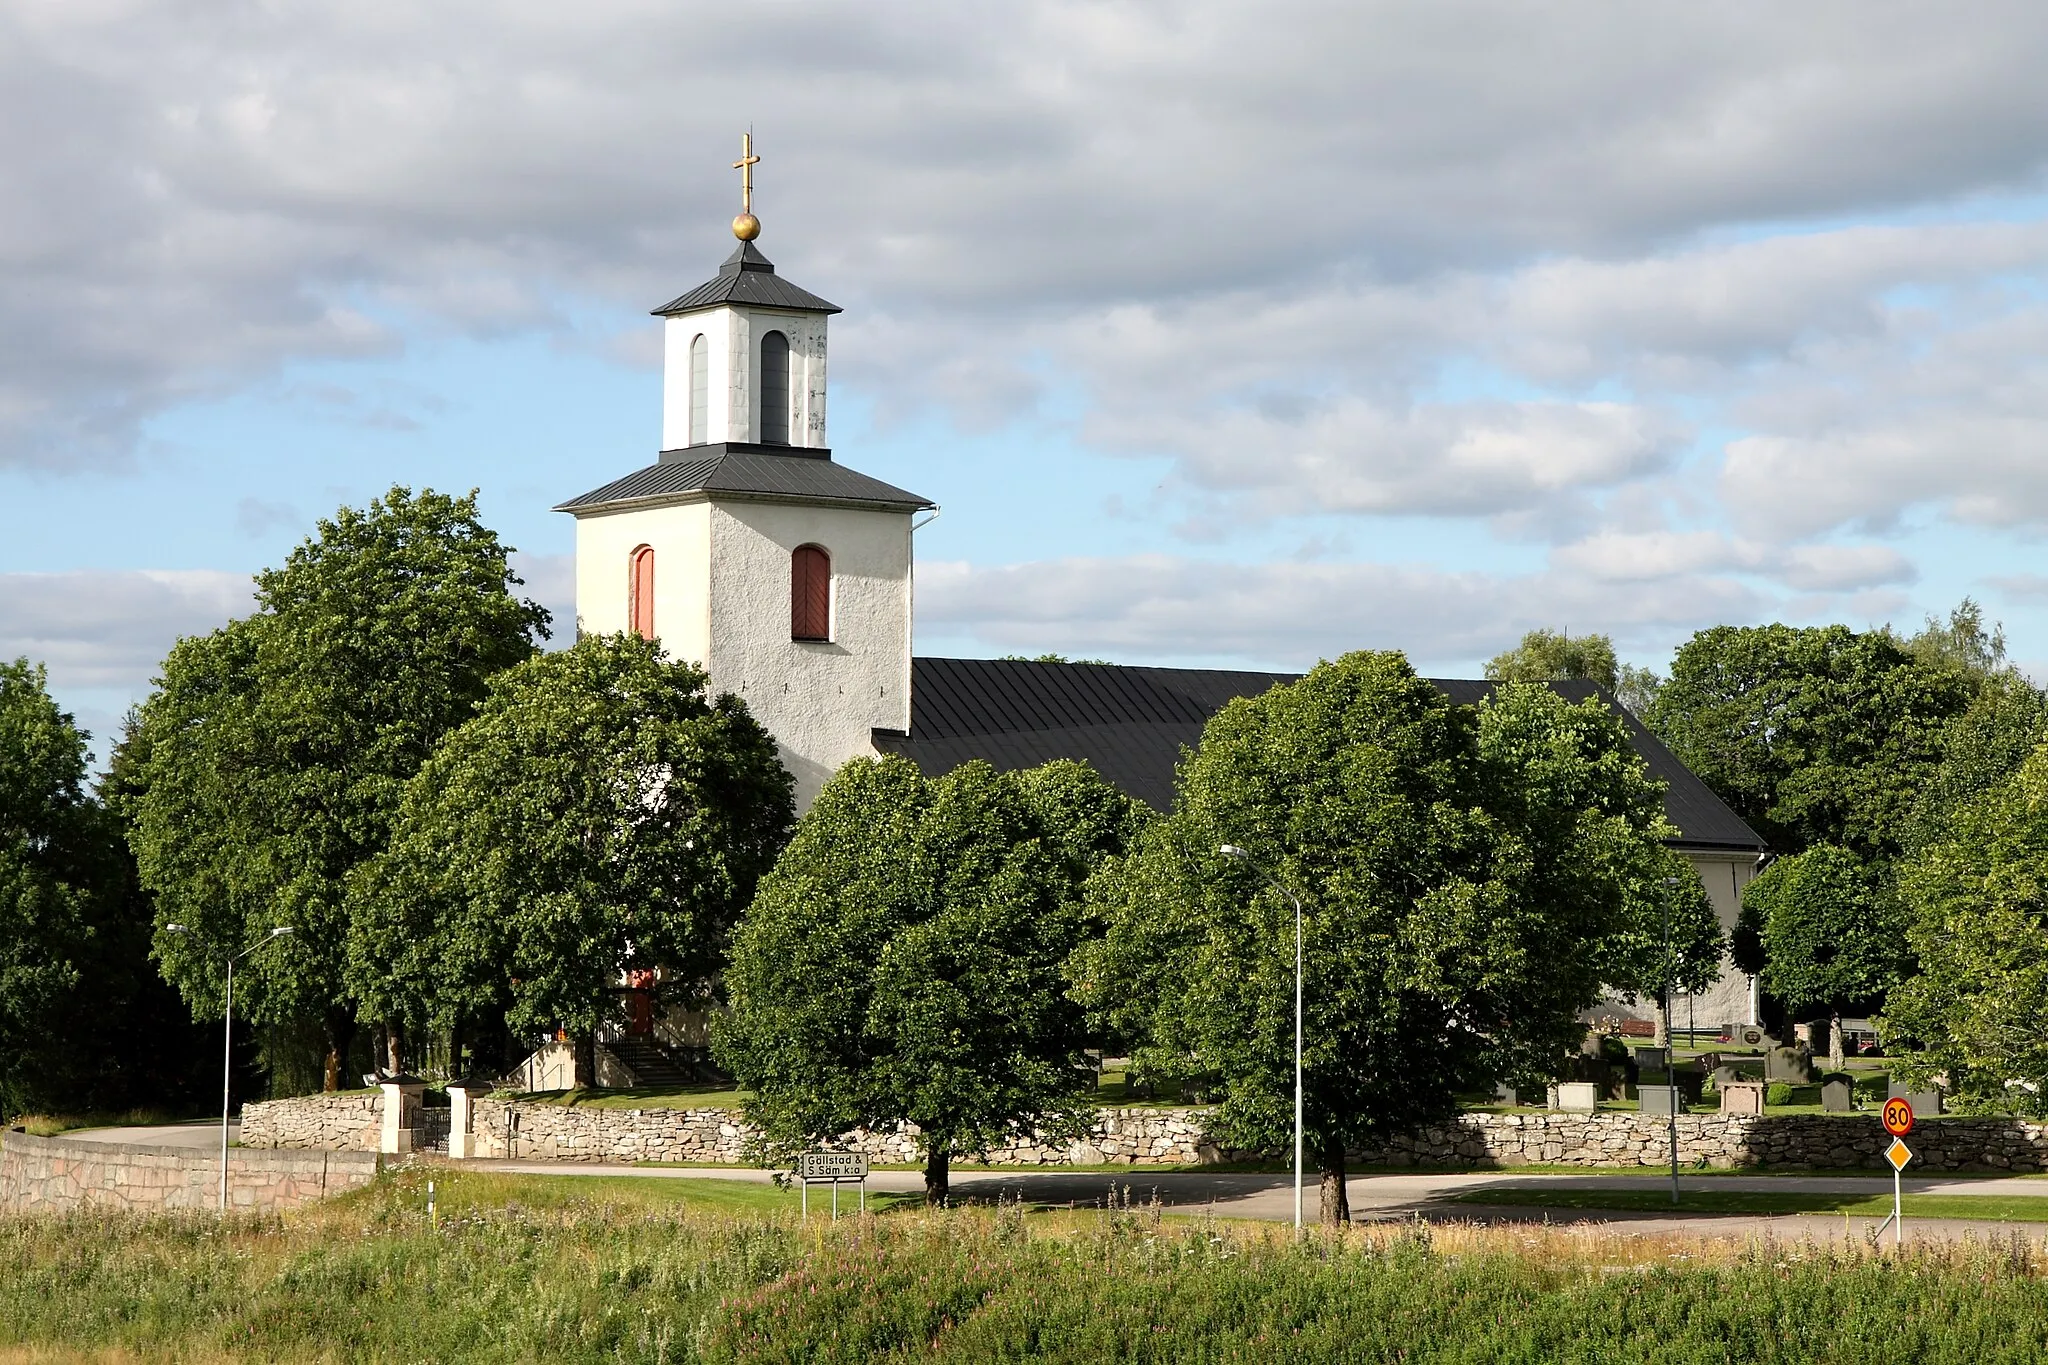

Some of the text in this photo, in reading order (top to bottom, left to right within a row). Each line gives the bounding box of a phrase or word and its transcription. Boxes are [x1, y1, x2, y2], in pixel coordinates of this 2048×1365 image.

[1888, 1107, 1908, 1126] 80
[808, 1155, 862, 1165] Gällstad &
[808, 1165, 860, 1175] S Säm k:a
